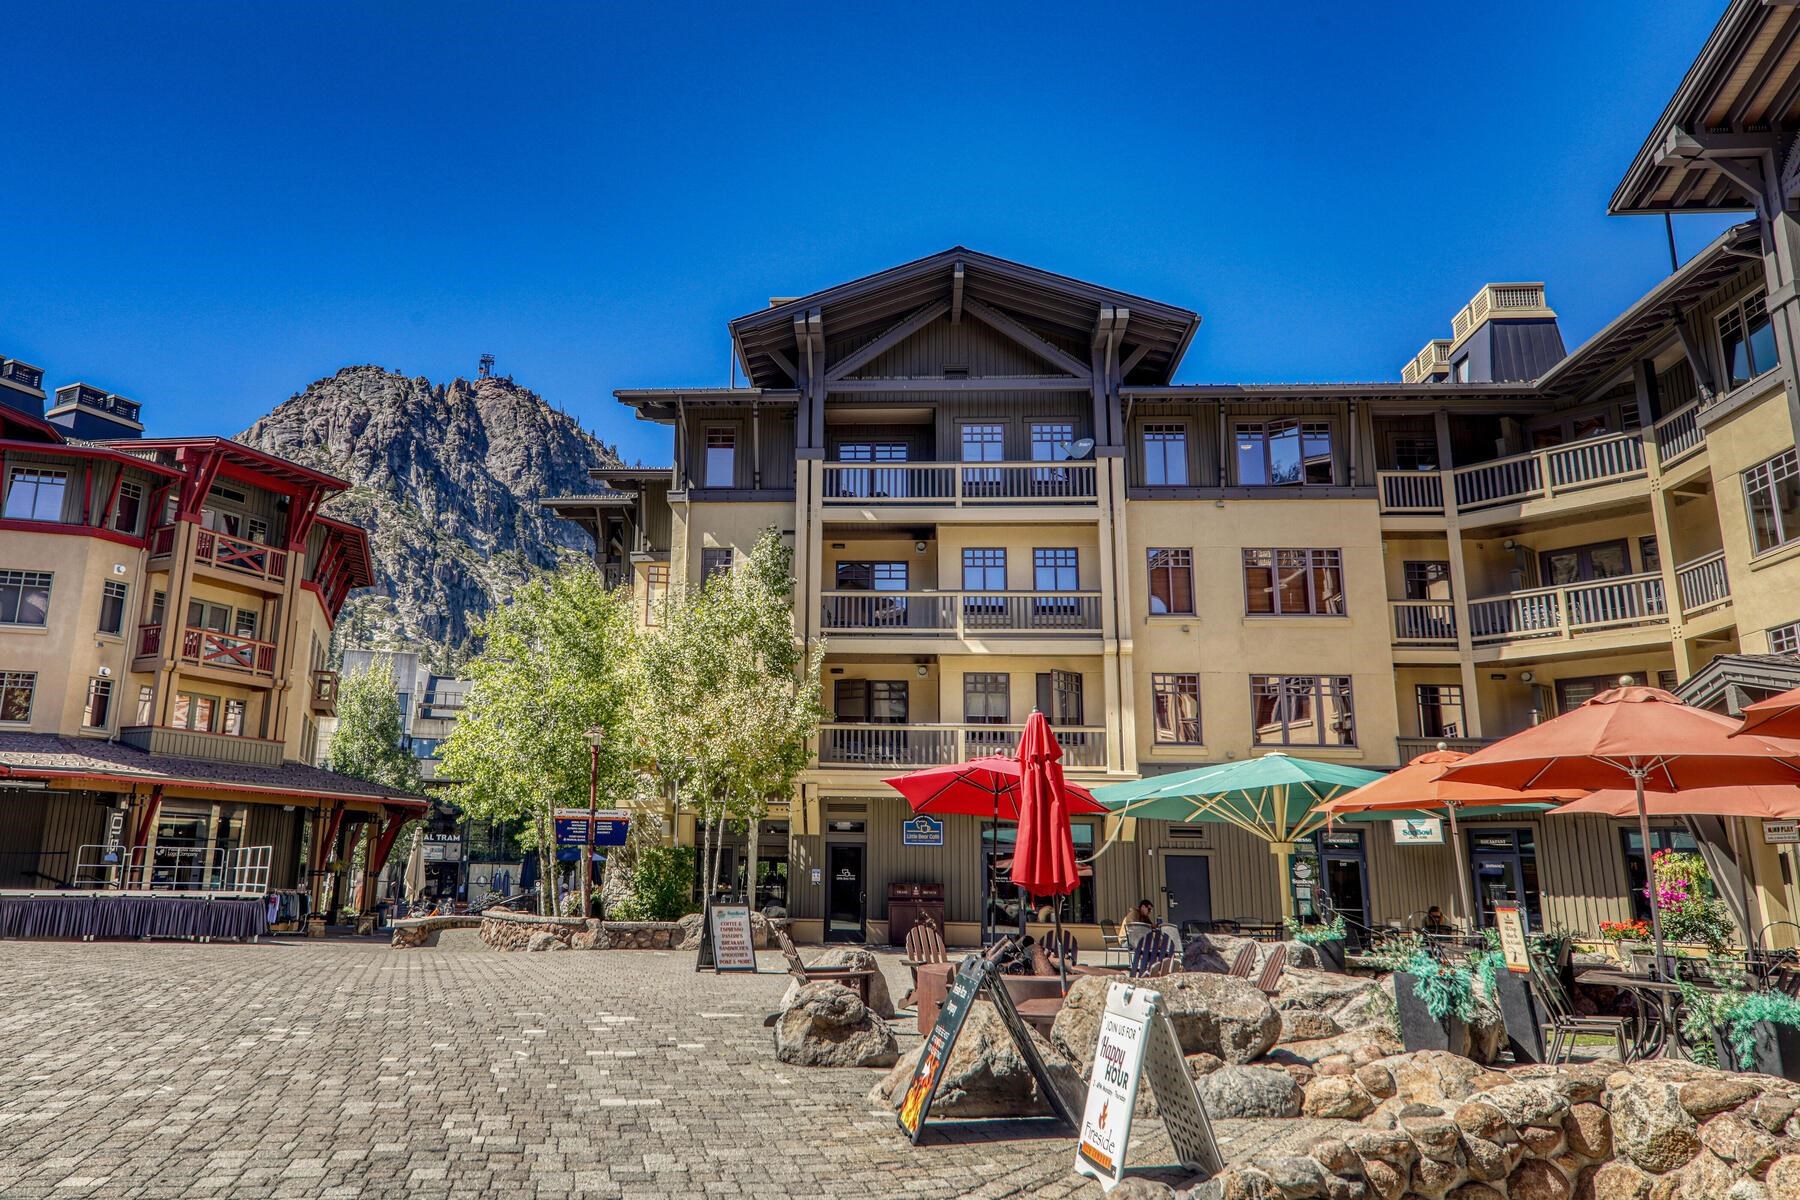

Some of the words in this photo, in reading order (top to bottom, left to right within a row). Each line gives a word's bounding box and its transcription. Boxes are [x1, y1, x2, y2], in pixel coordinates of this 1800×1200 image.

[1106, 1022, 1118, 1036] JOIN
[1118, 1024, 1126, 1037] US
[1126, 1028, 1136, 1040] FOR
[1100, 1036, 1126, 1069] Happy
[1104, 1063, 1129, 1090] HOUR
[1084, 1121, 1116, 1154] Fireside
